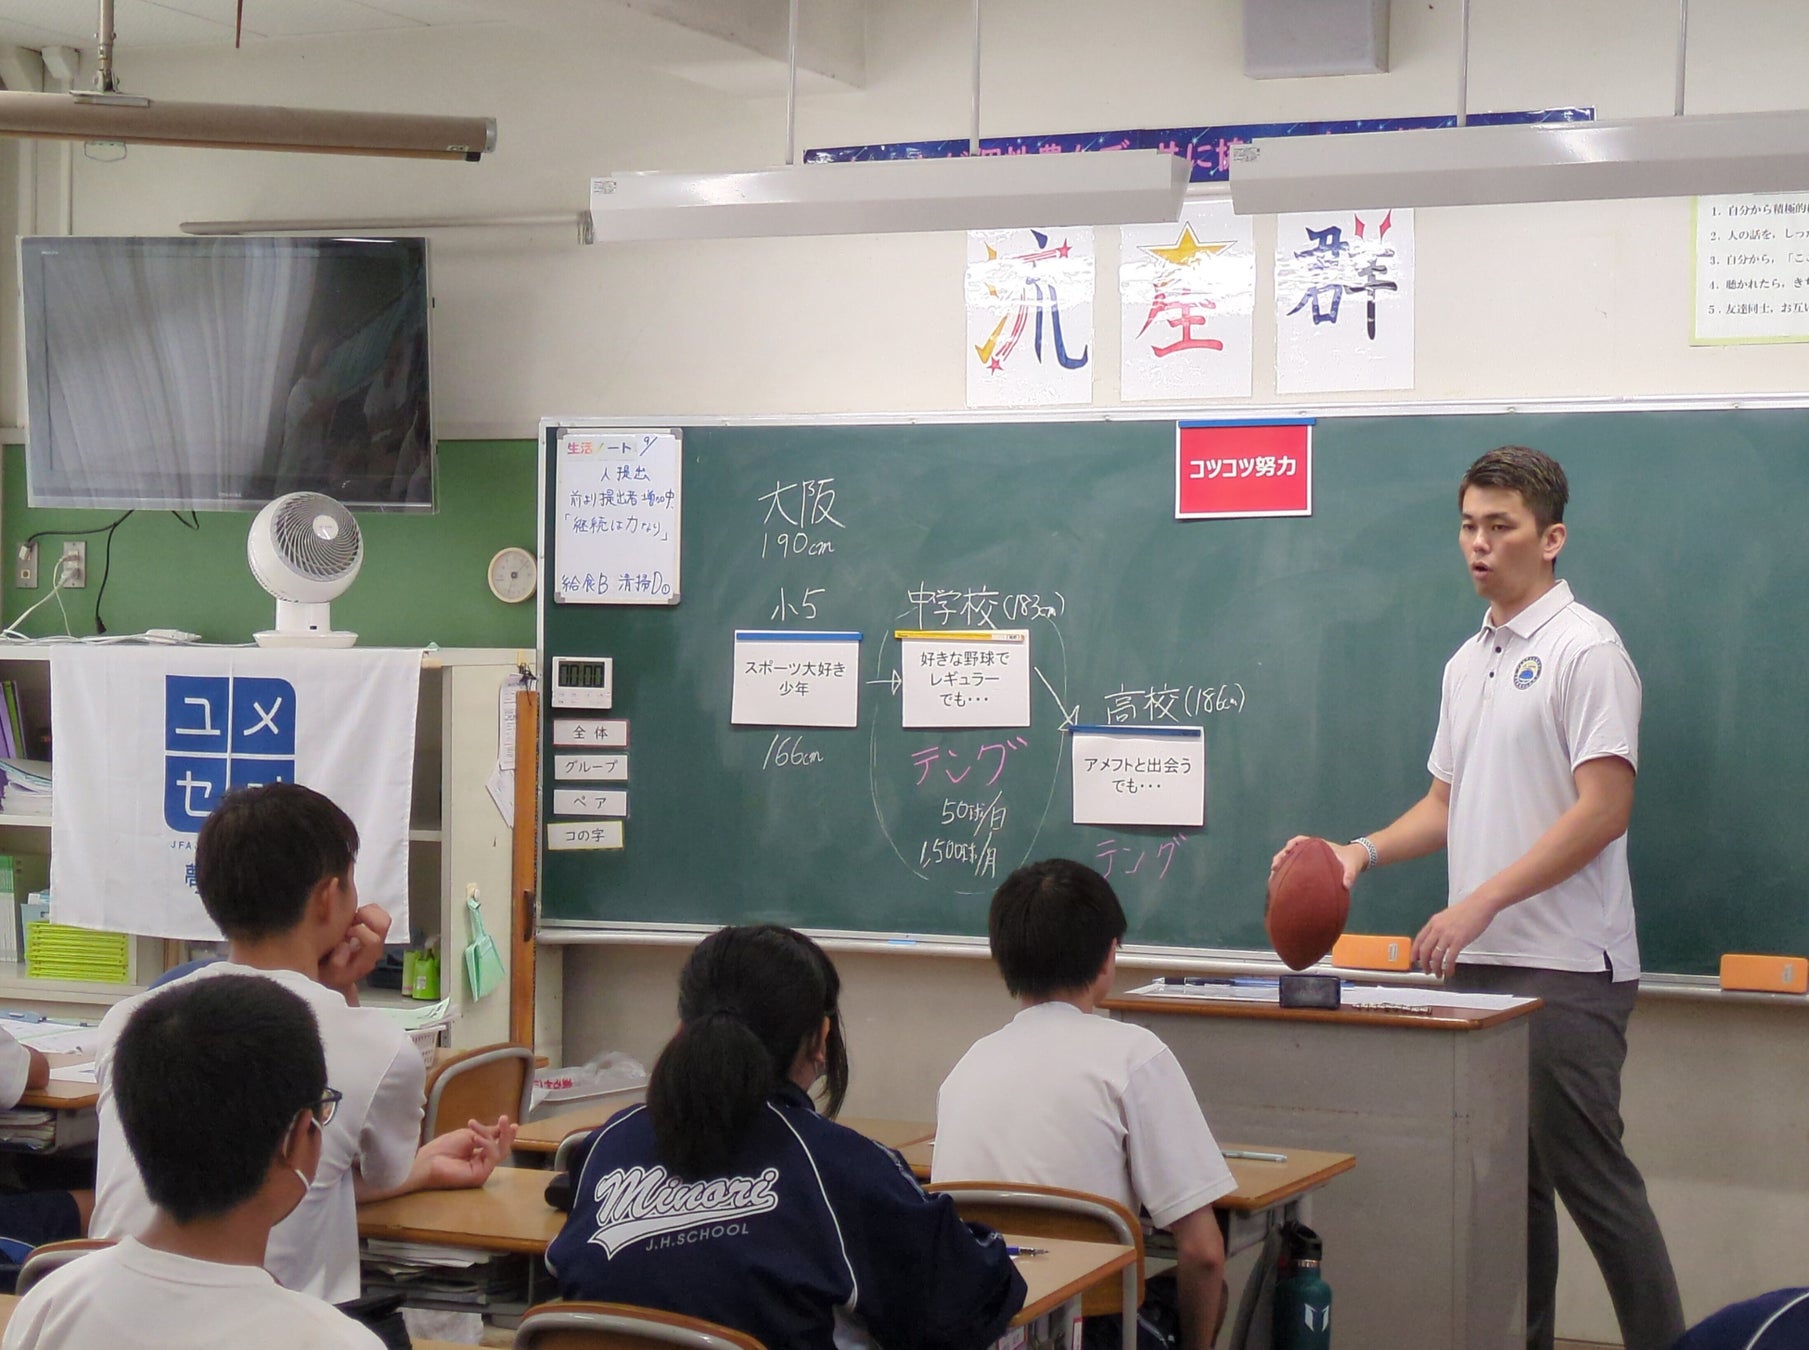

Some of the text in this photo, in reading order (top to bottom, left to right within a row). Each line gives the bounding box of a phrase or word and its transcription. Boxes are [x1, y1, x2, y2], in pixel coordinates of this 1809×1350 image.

[567, 441, 632, 455] 生活ノート
[1189, 455, 1297, 479] コツコツ努力
[758, 478, 847, 529] 大阪
[761, 532, 836, 559] 190cm
[769, 586, 827, 622] 小5
[744, 660, 846, 678] スポーツ大好き
[920, 651, 1011, 667] 好きな野球で
[778, 680, 810, 697] 少年
[930, 671, 1000, 687] レギュラー
[174, 697, 283, 737] ユメ
[761, 733, 825, 771] 166cm
[911, 735, 1029, 786] テング
[564, 759, 619, 774] グループ
[1083, 757, 1193, 774] アメフトと出会う
[170, 840, 193, 851] JFA
[564, 828, 606, 843] コの字
[594, 1165, 779, 1227] Minori
[645, 1222, 750, 1252] J.H.SCHOOL
